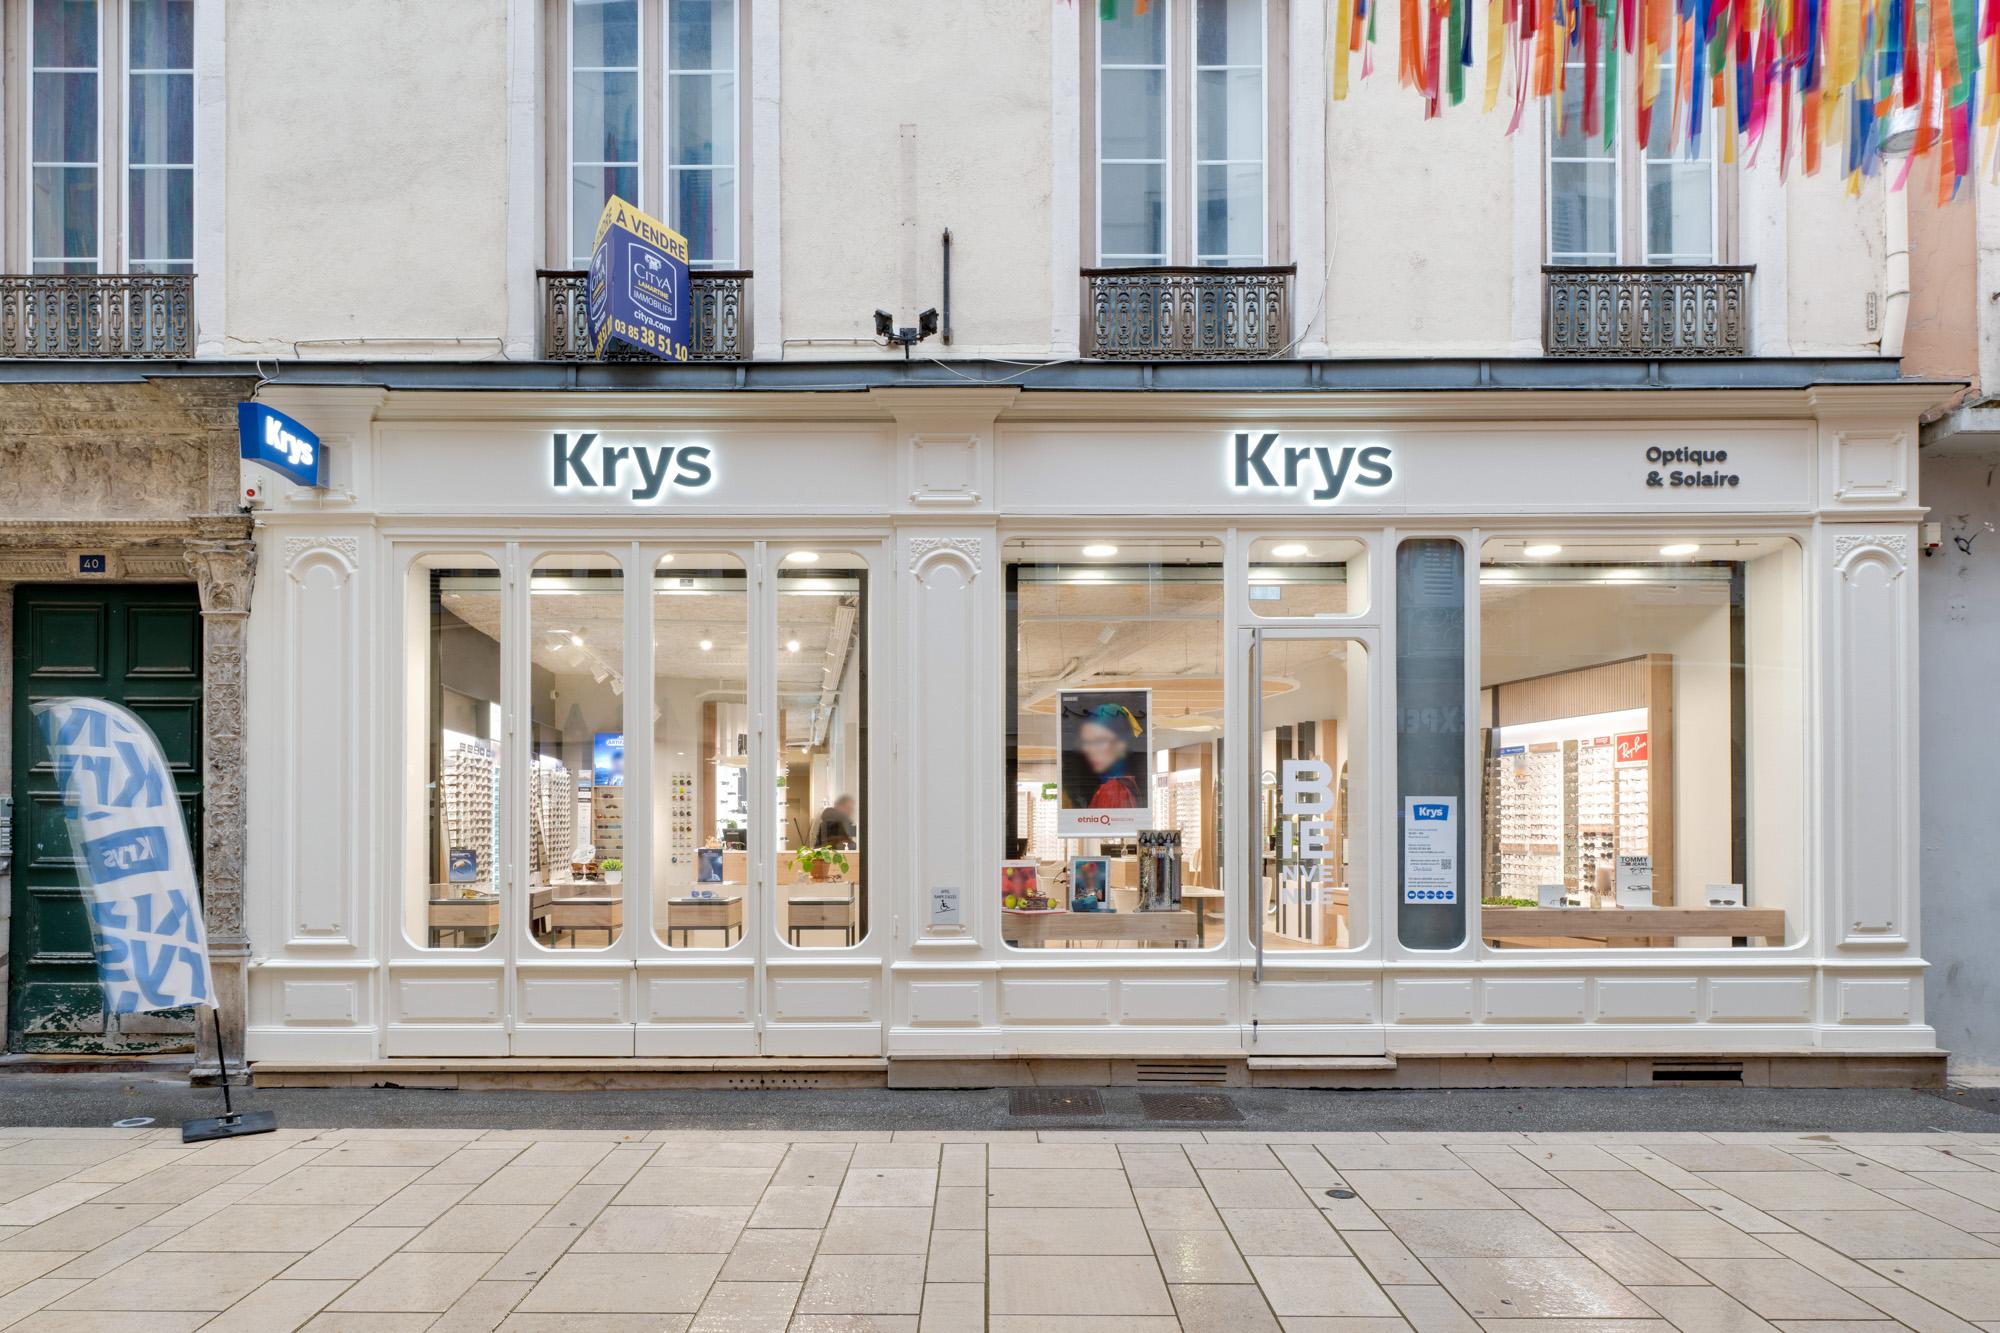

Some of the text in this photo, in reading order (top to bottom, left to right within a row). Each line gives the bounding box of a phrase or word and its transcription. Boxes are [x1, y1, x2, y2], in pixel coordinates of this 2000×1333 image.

[616, 202, 627, 228] À
[631, 215, 686, 261] VENDRE
[638, 279, 669, 300] LAMARTINE
[633, 290, 673, 316] IMMOBILIER
[633, 310, 671, 334] citya.com
[615, 319, 626, 335] 03
[628, 325, 639, 340] 85
[640, 326, 656, 348] 38
[658, 334, 673, 356] 51
[675, 342, 688, 362] 10
[265, 415, 314, 466] Krys
[553, 433, 712, 500] Krys
[1234, 433, 1393, 500] Krys
[1645, 446, 1728, 466] Optique
[1645, 470, 1740, 487] & Solaire
[83, 558, 99, 569] 40
[1077, 815, 1099, 823] etnia
[1418, 806, 1443, 818] Krys
